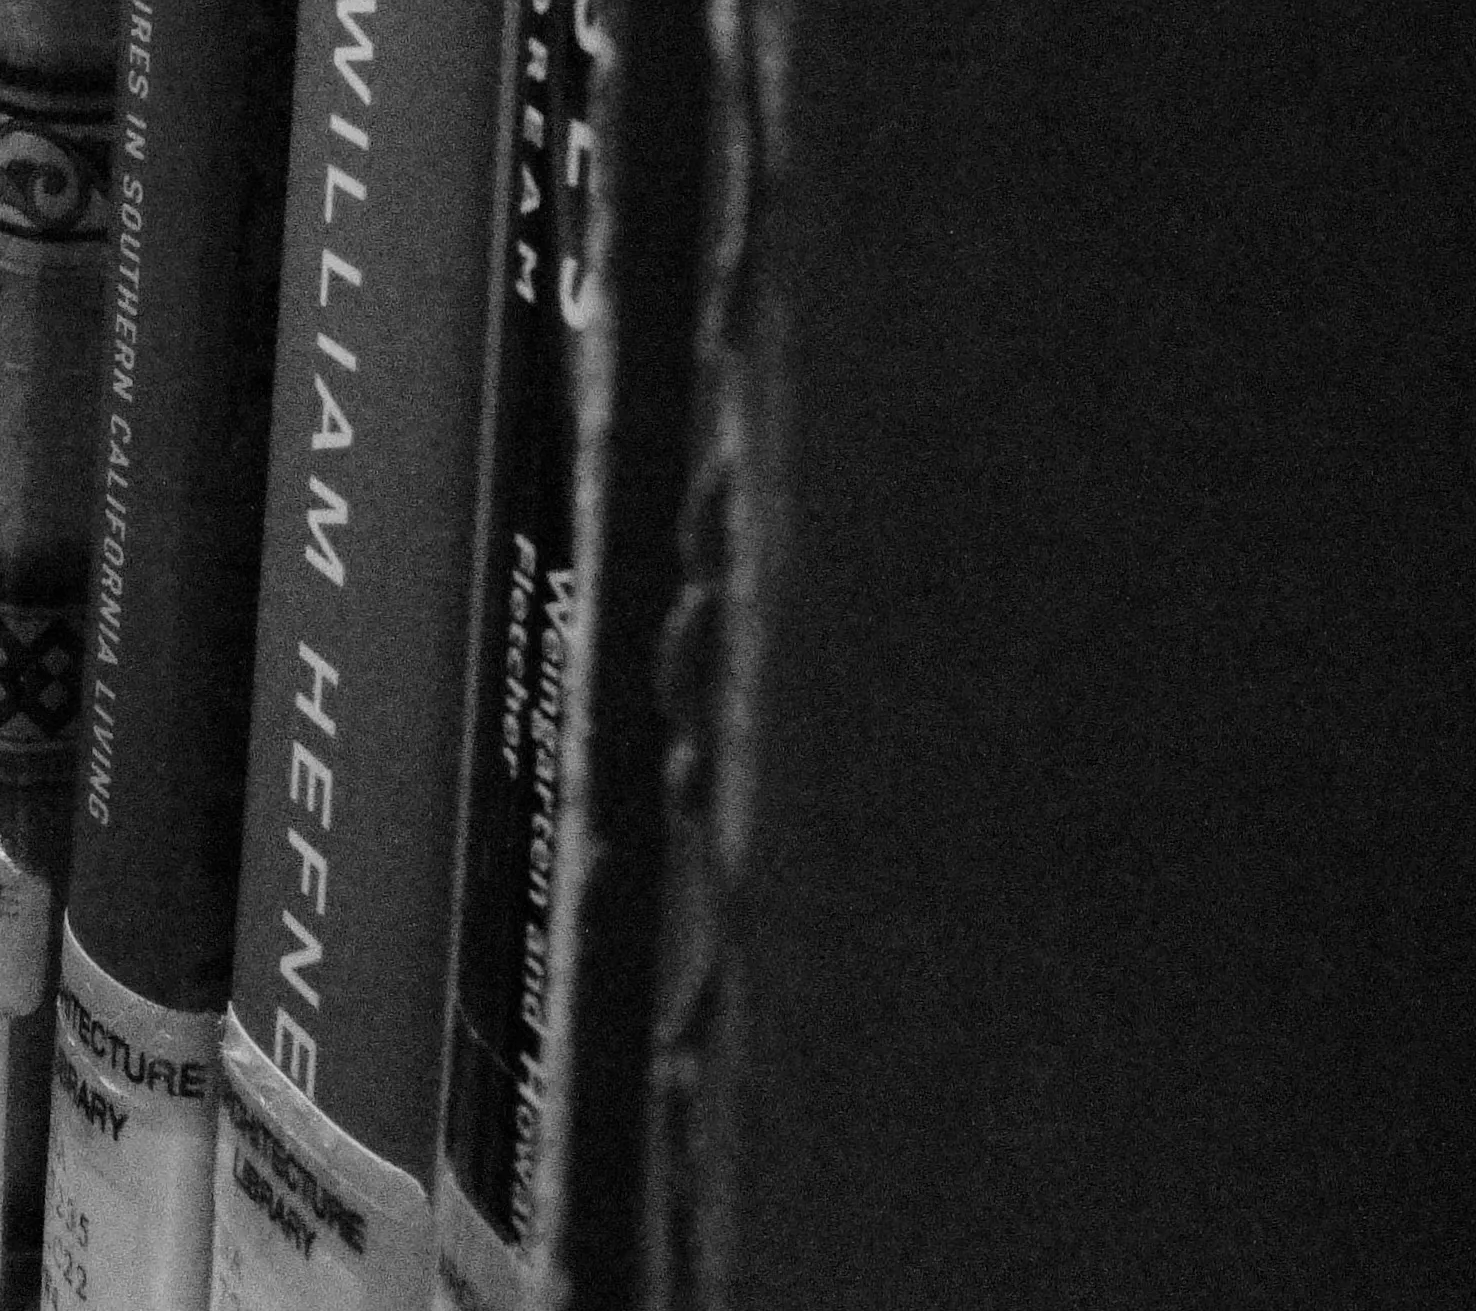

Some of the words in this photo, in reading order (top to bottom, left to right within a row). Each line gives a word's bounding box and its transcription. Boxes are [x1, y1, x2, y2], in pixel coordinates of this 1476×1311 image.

[122, 114, 145, 161] IN
[111, 173, 144, 403] SOUTHERN
[93, 414, 134, 671] CALIFORNIA
[500, 531, 540, 781] Fletcher
[86, 679, 117, 827] LIVING
[526, 564, 577, 909] Weingarten
[272, 639, 342, 1097] HEFNE
[520, 919, 554, 1041] and
[508, 1047, 550, 1247] Howar
